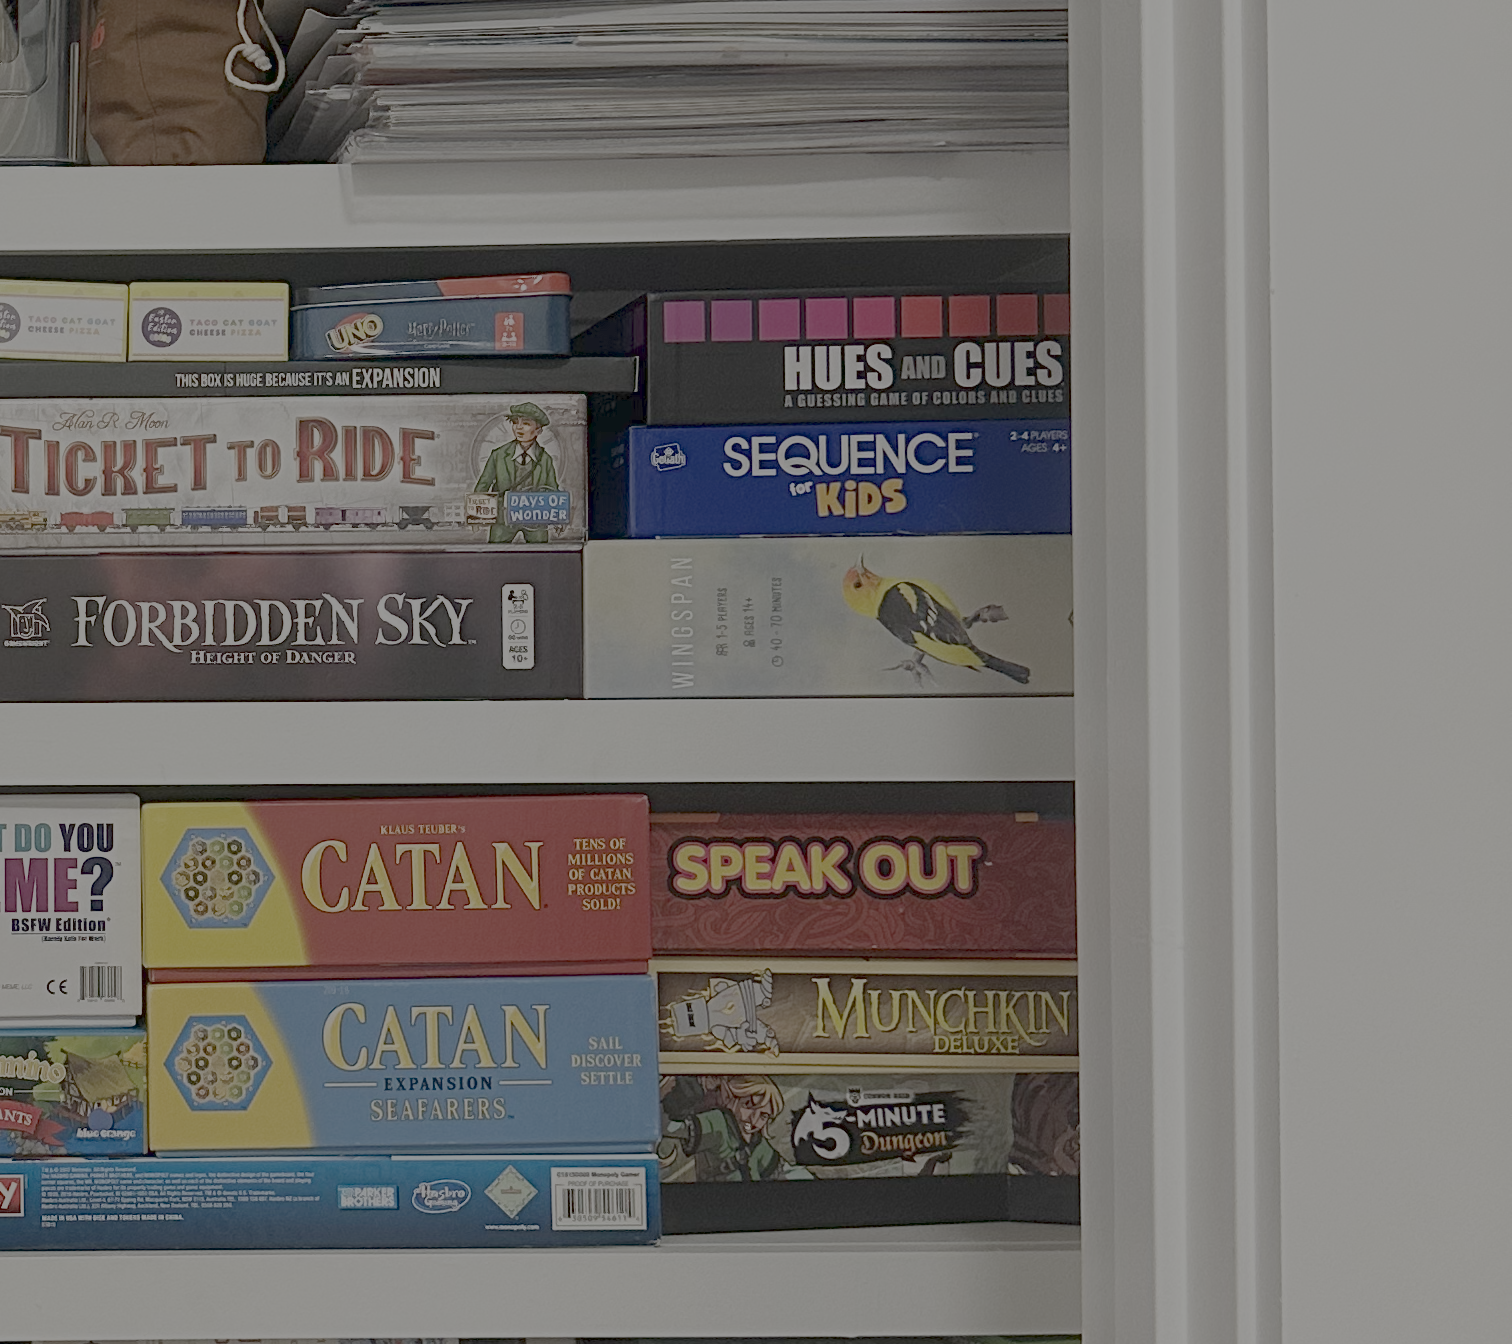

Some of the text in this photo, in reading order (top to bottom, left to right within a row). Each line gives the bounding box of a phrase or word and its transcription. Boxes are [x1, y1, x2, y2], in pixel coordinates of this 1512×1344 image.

[28, 315, 116, 326] TACO CAT GOAT
[28, 325, 101, 336] CHEESE PIZZA
[326, 314, 384, 352] UNO
[784, 340, 1064, 391] HUES AND CUES
[175, 367, 441, 389] THIS BOX IS HUGE BECAUSE IT'S AN EXPANSION
[784, 389, 1064, 408] A GUESSING GAME OF COLORS AND CLUES
[227, 439, 282, 482] TO
[292, 415, 437, 487] RIDE
[722, 432, 974, 478] SEQUENCE
[789, 481, 814, 496] for
[70, 592, 474, 653] FORBIDDEN SKY
[670, 557, 694, 690] WINGSPAN
[190, 650, 357, 666] HEIGHT OF DANGER
[14, 822, 52, 853] DO
[59, 822, 114, 853] YOU
[573, 838, 628, 852] TENS OF
[567, 852, 635, 867] MILLIONS
[671, 840, 983, 895] SPEAK OUT
[301, 840, 544, 913] CATAN
[568, 867, 633, 882] OF CATAN
[567, 883, 636, 897] PRODUCTS
[582, 897, 622, 912] SOLD!
[11, 917, 106, 933] BSFW Edition
[811, 976, 1072, 1047] MUNCHKIN
[322, 1002, 551, 1070] CATAN
[588, 1035, 624, 1051] SAIL
[932, 1034, 1021, 1054] DELUXE
[570, 1052, 643, 1069] DISCOVER
[383, 1076, 493, 1092] EXPANSION
[580, 1071, 634, 1086] SETTLE
[370, 1097, 507, 1122] SEAFARERS
[860, 1131, 948, 1156] Dungeon
[420, 1182, 466, 1201] Hasbro
